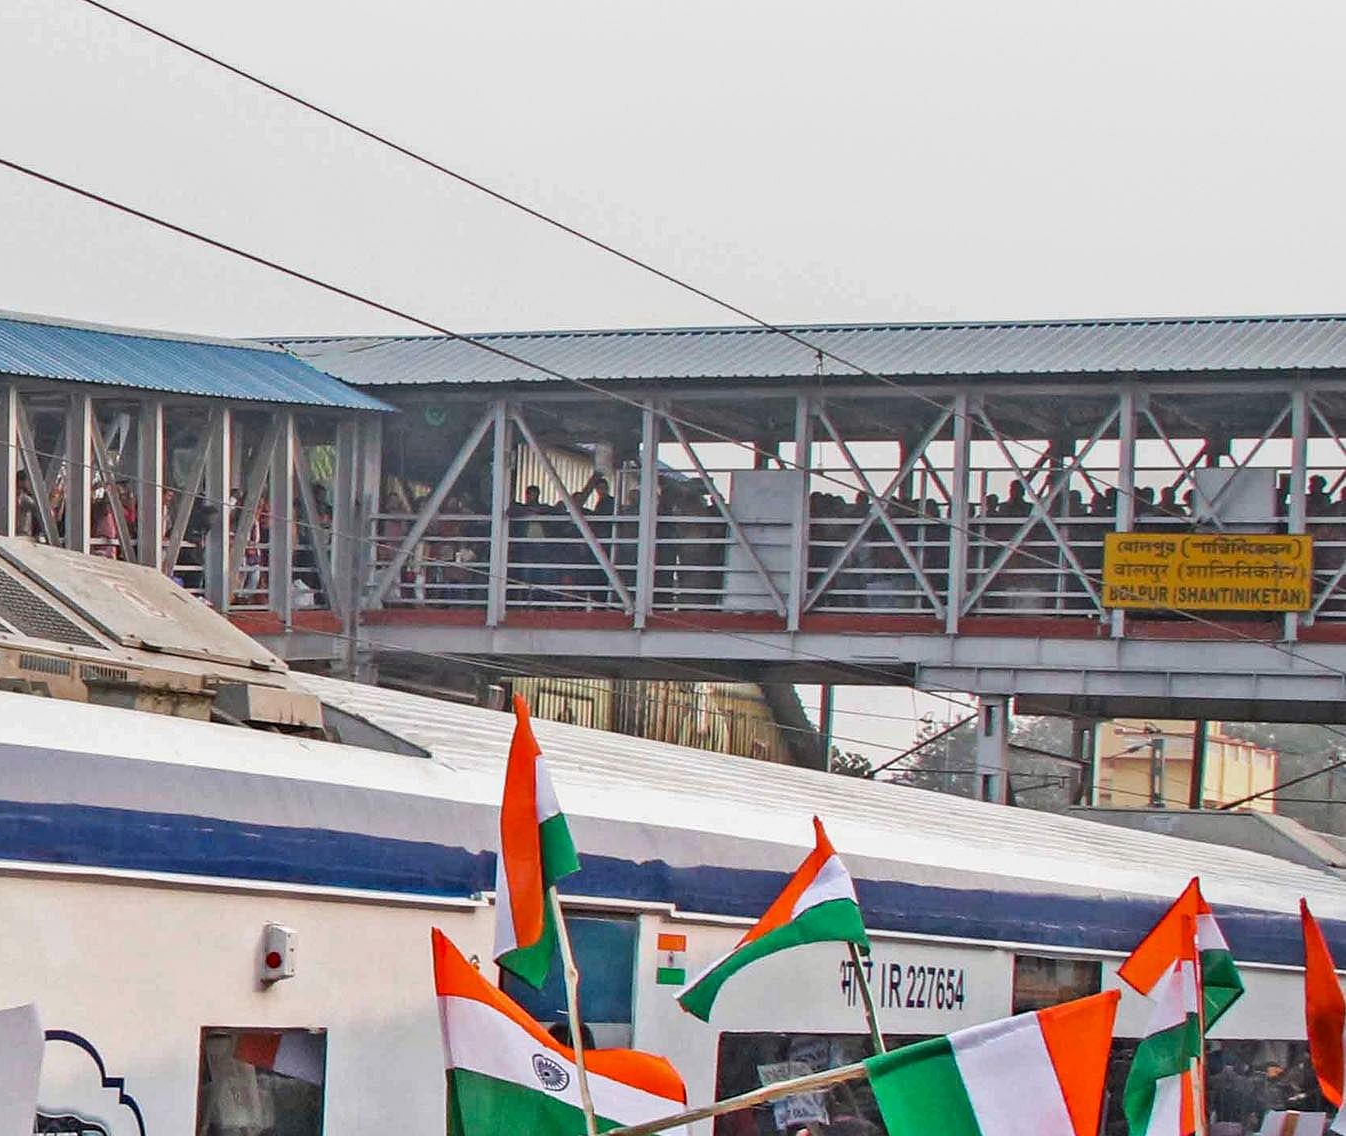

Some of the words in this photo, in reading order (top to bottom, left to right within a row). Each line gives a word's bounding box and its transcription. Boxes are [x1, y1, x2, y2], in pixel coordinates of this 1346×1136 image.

[1109, 586, 1167, 603] BOLPUR
[1173, 586, 1306, 607] (SHANTINIKETAN)
[905, 965, 965, 1010] 227654
